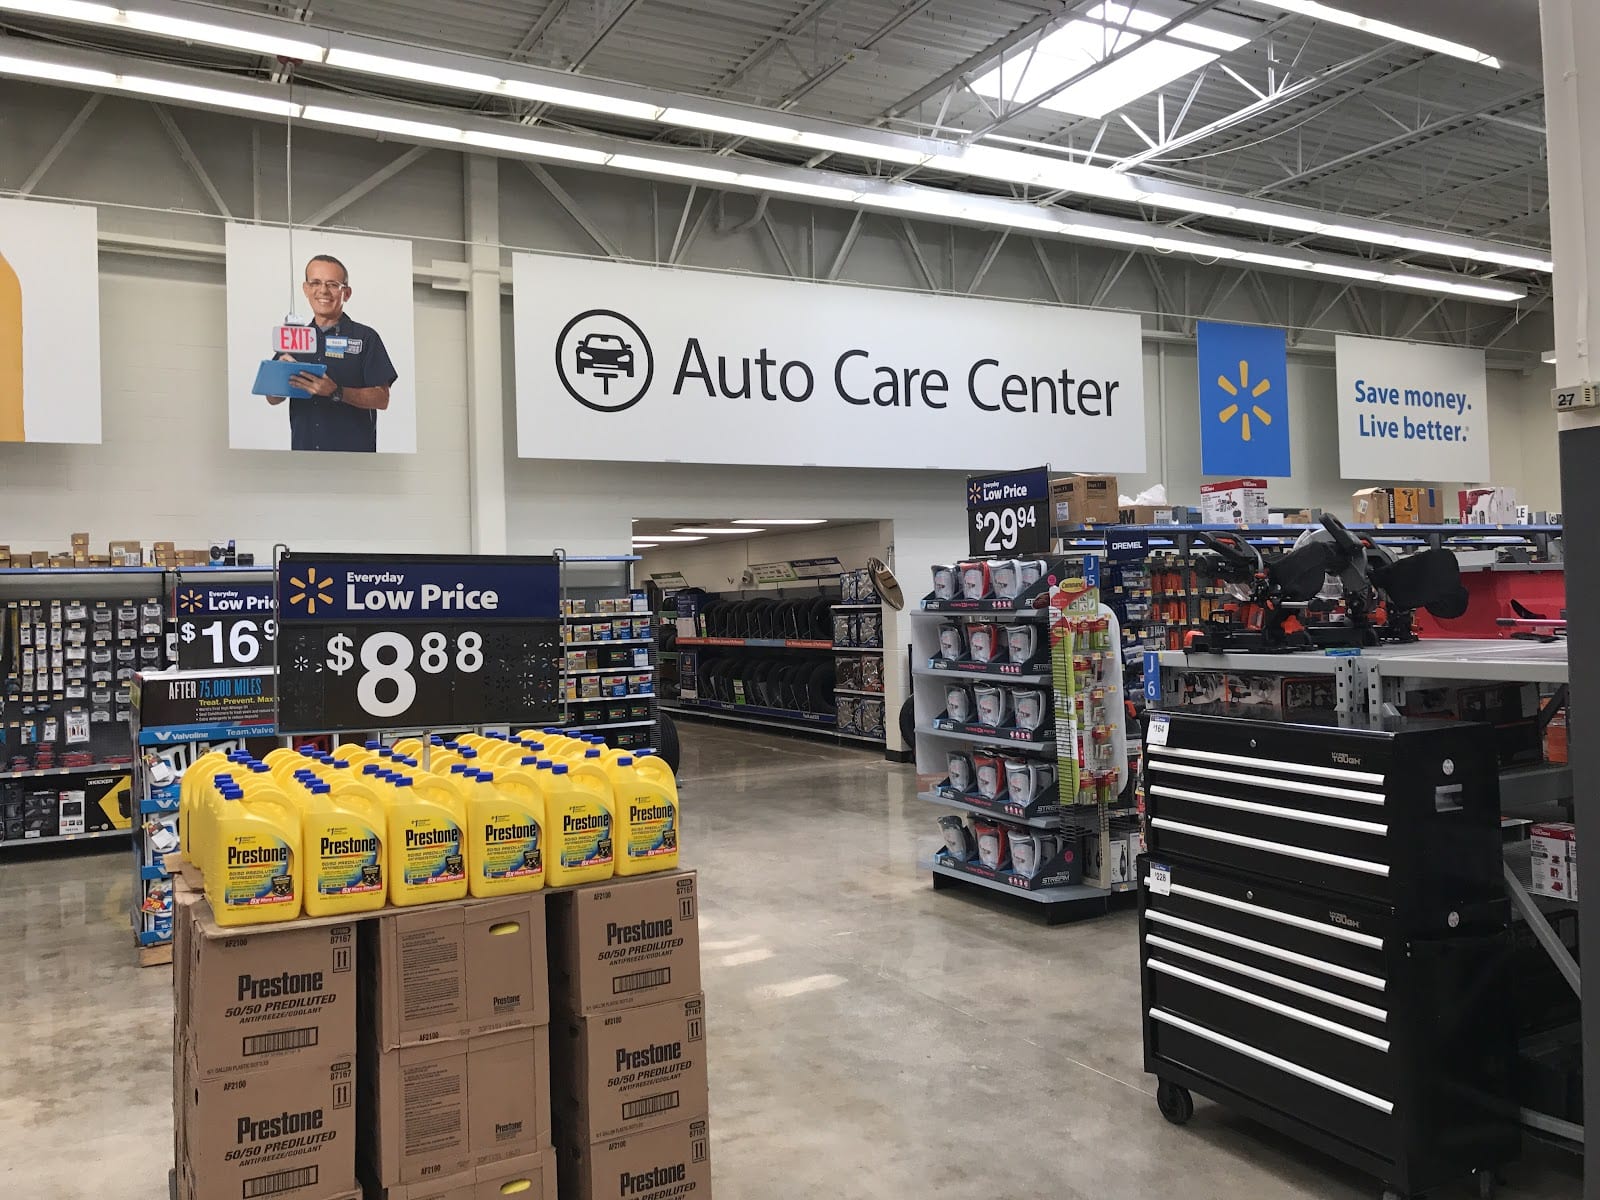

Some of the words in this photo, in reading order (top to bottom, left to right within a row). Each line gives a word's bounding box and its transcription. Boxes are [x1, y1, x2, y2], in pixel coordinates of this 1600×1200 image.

[280, 327, 311, 350] EXIT
[672, 337, 815, 402] Auto
[834, 349, 949, 408] Care
[967, 358, 1120, 417] Center
[1354, 379, 1400, 405] Save
[1404, 387, 1472, 416] money.
[1557, 393, 1575, 406] 27
[1358, 413, 1399, 439] Live
[1403, 415, 1469, 443] better.
[983, 481, 1000, 490] Everyday
[983, 486, 1002, 502] Low
[1003, 484, 1028, 499] Price
[1112, 540, 1143, 551] DREMEL
[1087, 558, 1095, 571] J
[346, 571, 404, 586] Everyday
[1087, 575, 1096, 586] 5
[208, 590, 239, 599] Everyday
[346, 586, 416, 611] Low
[421, 582, 499, 610] Price
[208, 597, 244, 612] Low
[246, 597, 278, 611] Pric
[1147, 662, 1155, 674] J
[168, 681, 197, 700] AFTER
[234, 677, 262, 697] MILES
[1147, 684, 1156, 697] 6
[199, 699, 221, 707] Treat.
[223, 697, 255, 706] Prevent.
[172, 731, 209, 741] Valvoline
[226, 727, 274, 737] Team.Valvo
[1332, 756, 1361, 765] TOUGH
[629, 804, 673, 822] Prestone
[563, 814, 609, 832] Prestone
[405, 828, 458, 847] Prestone
[485, 824, 536, 842] Prestone
[228, 846, 288, 865] Prestone
[320, 837, 376, 856] Prestone
[1042, 875, 1070, 884] STREAM
[593, 892, 611, 900] AF2100
[1330, 915, 1360, 928] TOUGH
[224, 939, 248, 948] AF2100
[330, 935, 351, 944] 07167
[607, 919, 673, 946] Prestone
[598, 948, 626, 961] 50/50
[628, 937, 684, 956] PREDILUTED
[609, 949, 673, 966] ANTIFREEZE/COOLANT
[238, 972, 323, 1001] Prestone
[224, 1004, 261, 1018] 50/50
[264, 993, 337, 1012] PREDILUTED
[493, 994, 520, 1006] Prestone
[239, 1006, 323, 1025] ANTIFREEZE/COOLANT
[604, 1016, 622, 1026] AF2100
[419, 1032, 439, 1041] AF2100
[616, 1042, 681, 1072] Prestone
[223, 1080, 247, 1091] AF2100
[330, 1069, 352, 1081] 07167
[607, 1073, 635, 1088] 50/50
[637, 1060, 692, 1080] PREDILUTED
[618, 1073, 681, 1092] ANTIFREEZE/COOLANT
[237, 1109, 323, 1144] Prestone
[495, 1120, 523, 1133] Prestone
[224, 1146, 261, 1161] 50/50
[264, 1130, 337, 1152] PREDILUTED
[608, 1140, 626, 1151] AF2100
[238, 1145, 323, 1167] ANTIFREEZE/COOLANT
[421, 1164, 441, 1175] AF2100
[620, 1163, 686, 1197] Prestone
